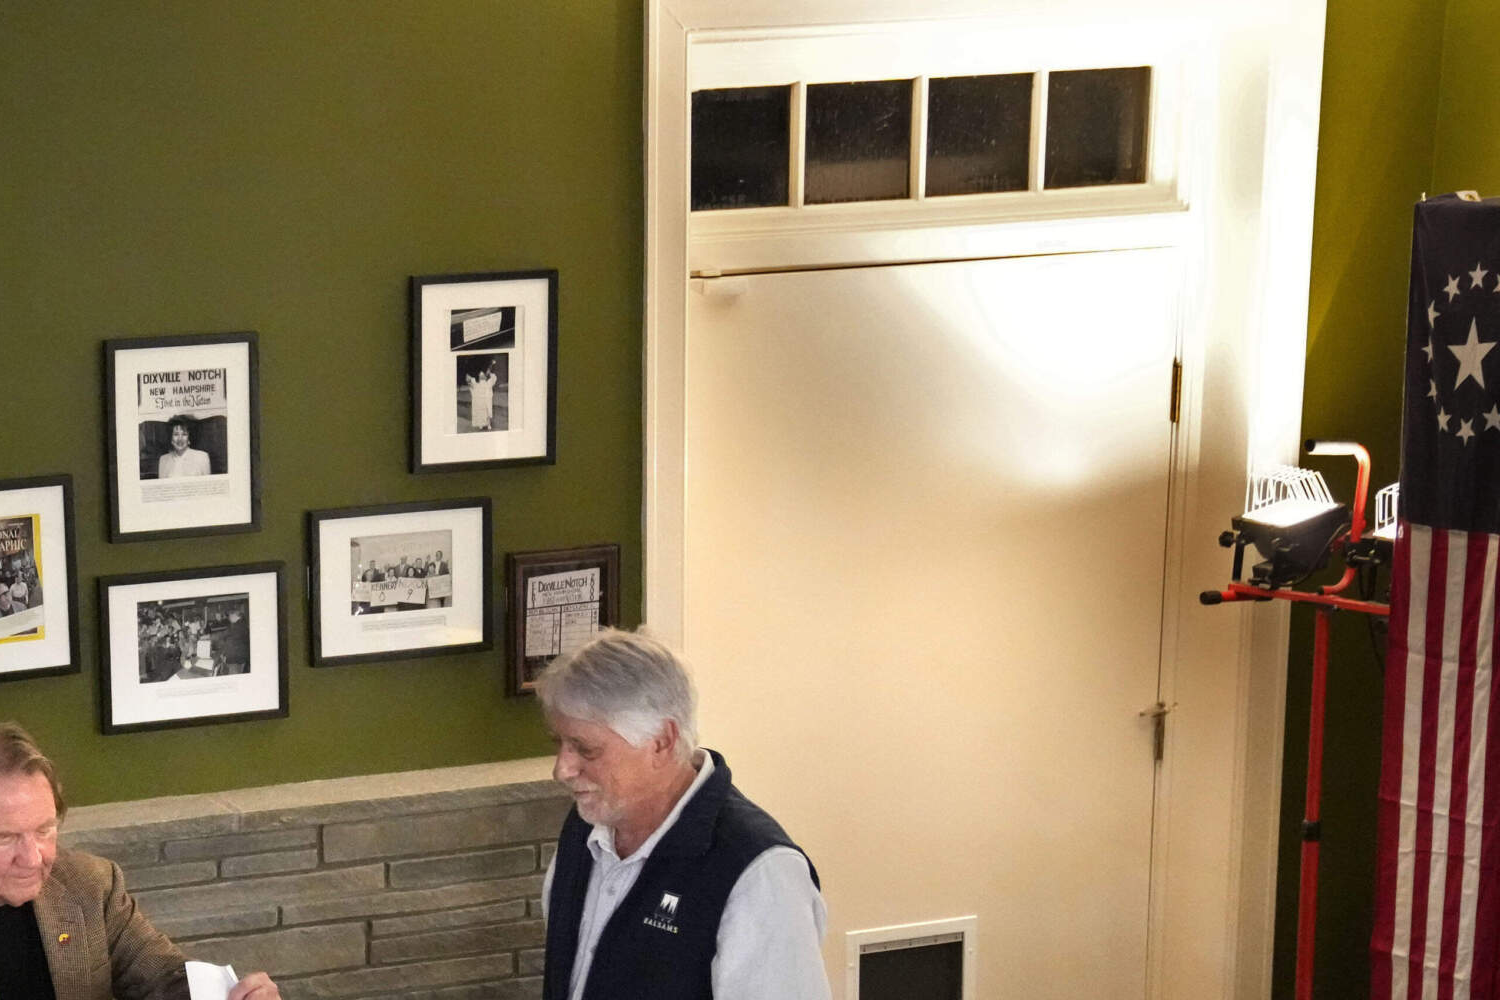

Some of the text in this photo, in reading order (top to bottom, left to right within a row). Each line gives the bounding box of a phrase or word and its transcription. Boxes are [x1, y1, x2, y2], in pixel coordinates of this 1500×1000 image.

[143, 369, 221, 384] DIXVILLE NOTCH
[150, 384, 216, 396] NEW HAMPSHIRE
